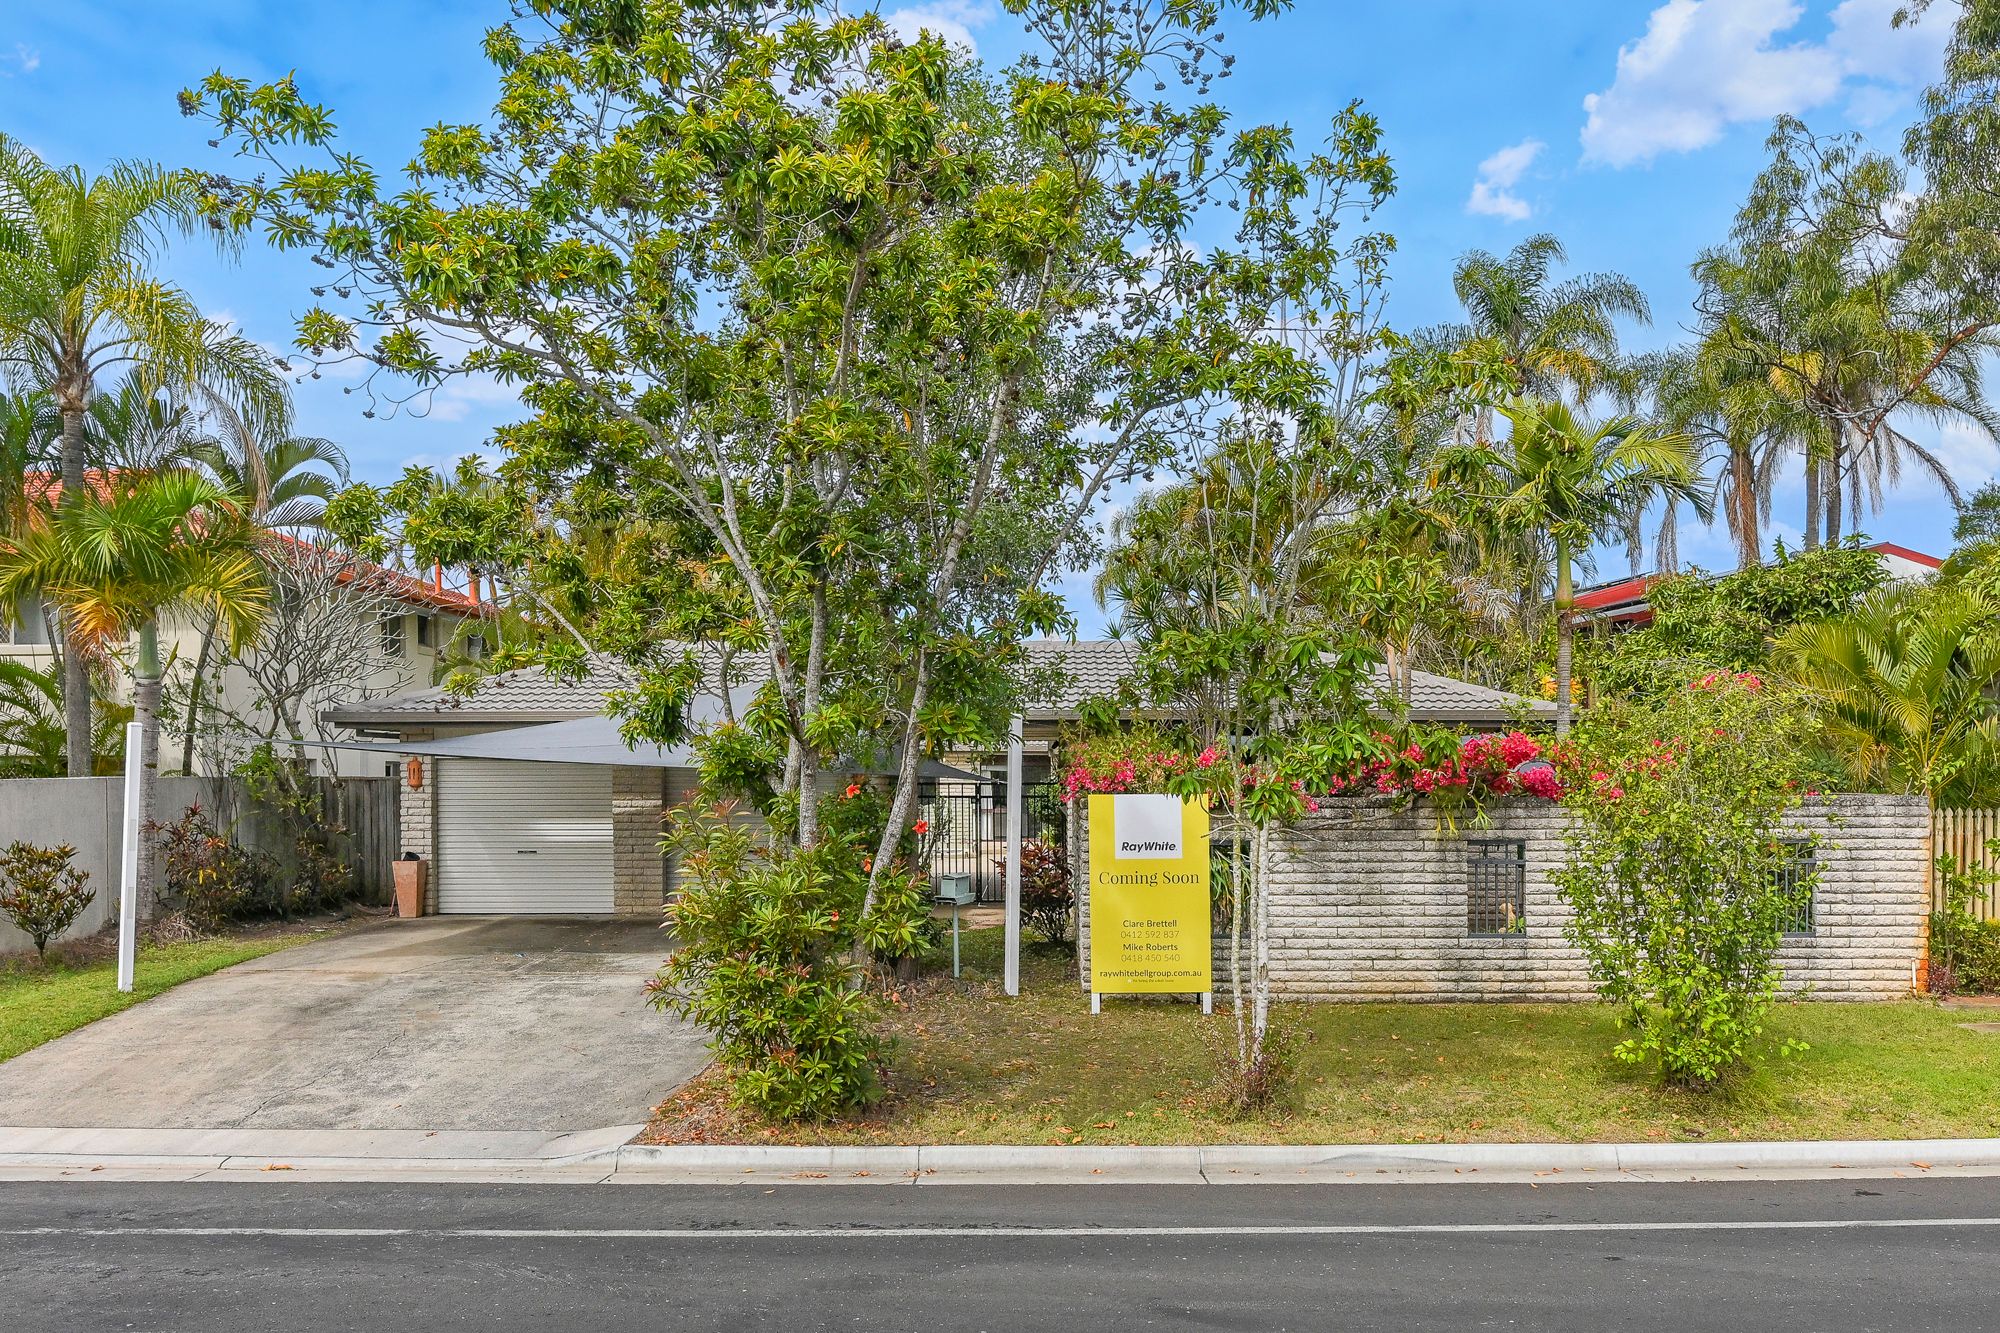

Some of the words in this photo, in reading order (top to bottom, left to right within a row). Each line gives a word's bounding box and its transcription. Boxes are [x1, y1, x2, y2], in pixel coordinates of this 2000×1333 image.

[1099, 871, 1159, 887] Coming
[1162, 871, 1199, 884] Soon
[1122, 920, 1144, 928] Clare
[1146, 920, 1177, 928] Brettell
[1120, 931, 1143, 939] 0412
[1145, 931, 1161, 939] 592
[1164, 931, 1180, 939] 837
[1123, 943, 1144, 951] Mike
[1146, 943, 1178, 951] Roberts
[1121, 954, 1143, 962] 0418
[1145, 954, 1162, 962] 450
[1164, 954, 1181, 962] 540
[1100, 969, 1202, 979] raywhitebellgroup.com.au
